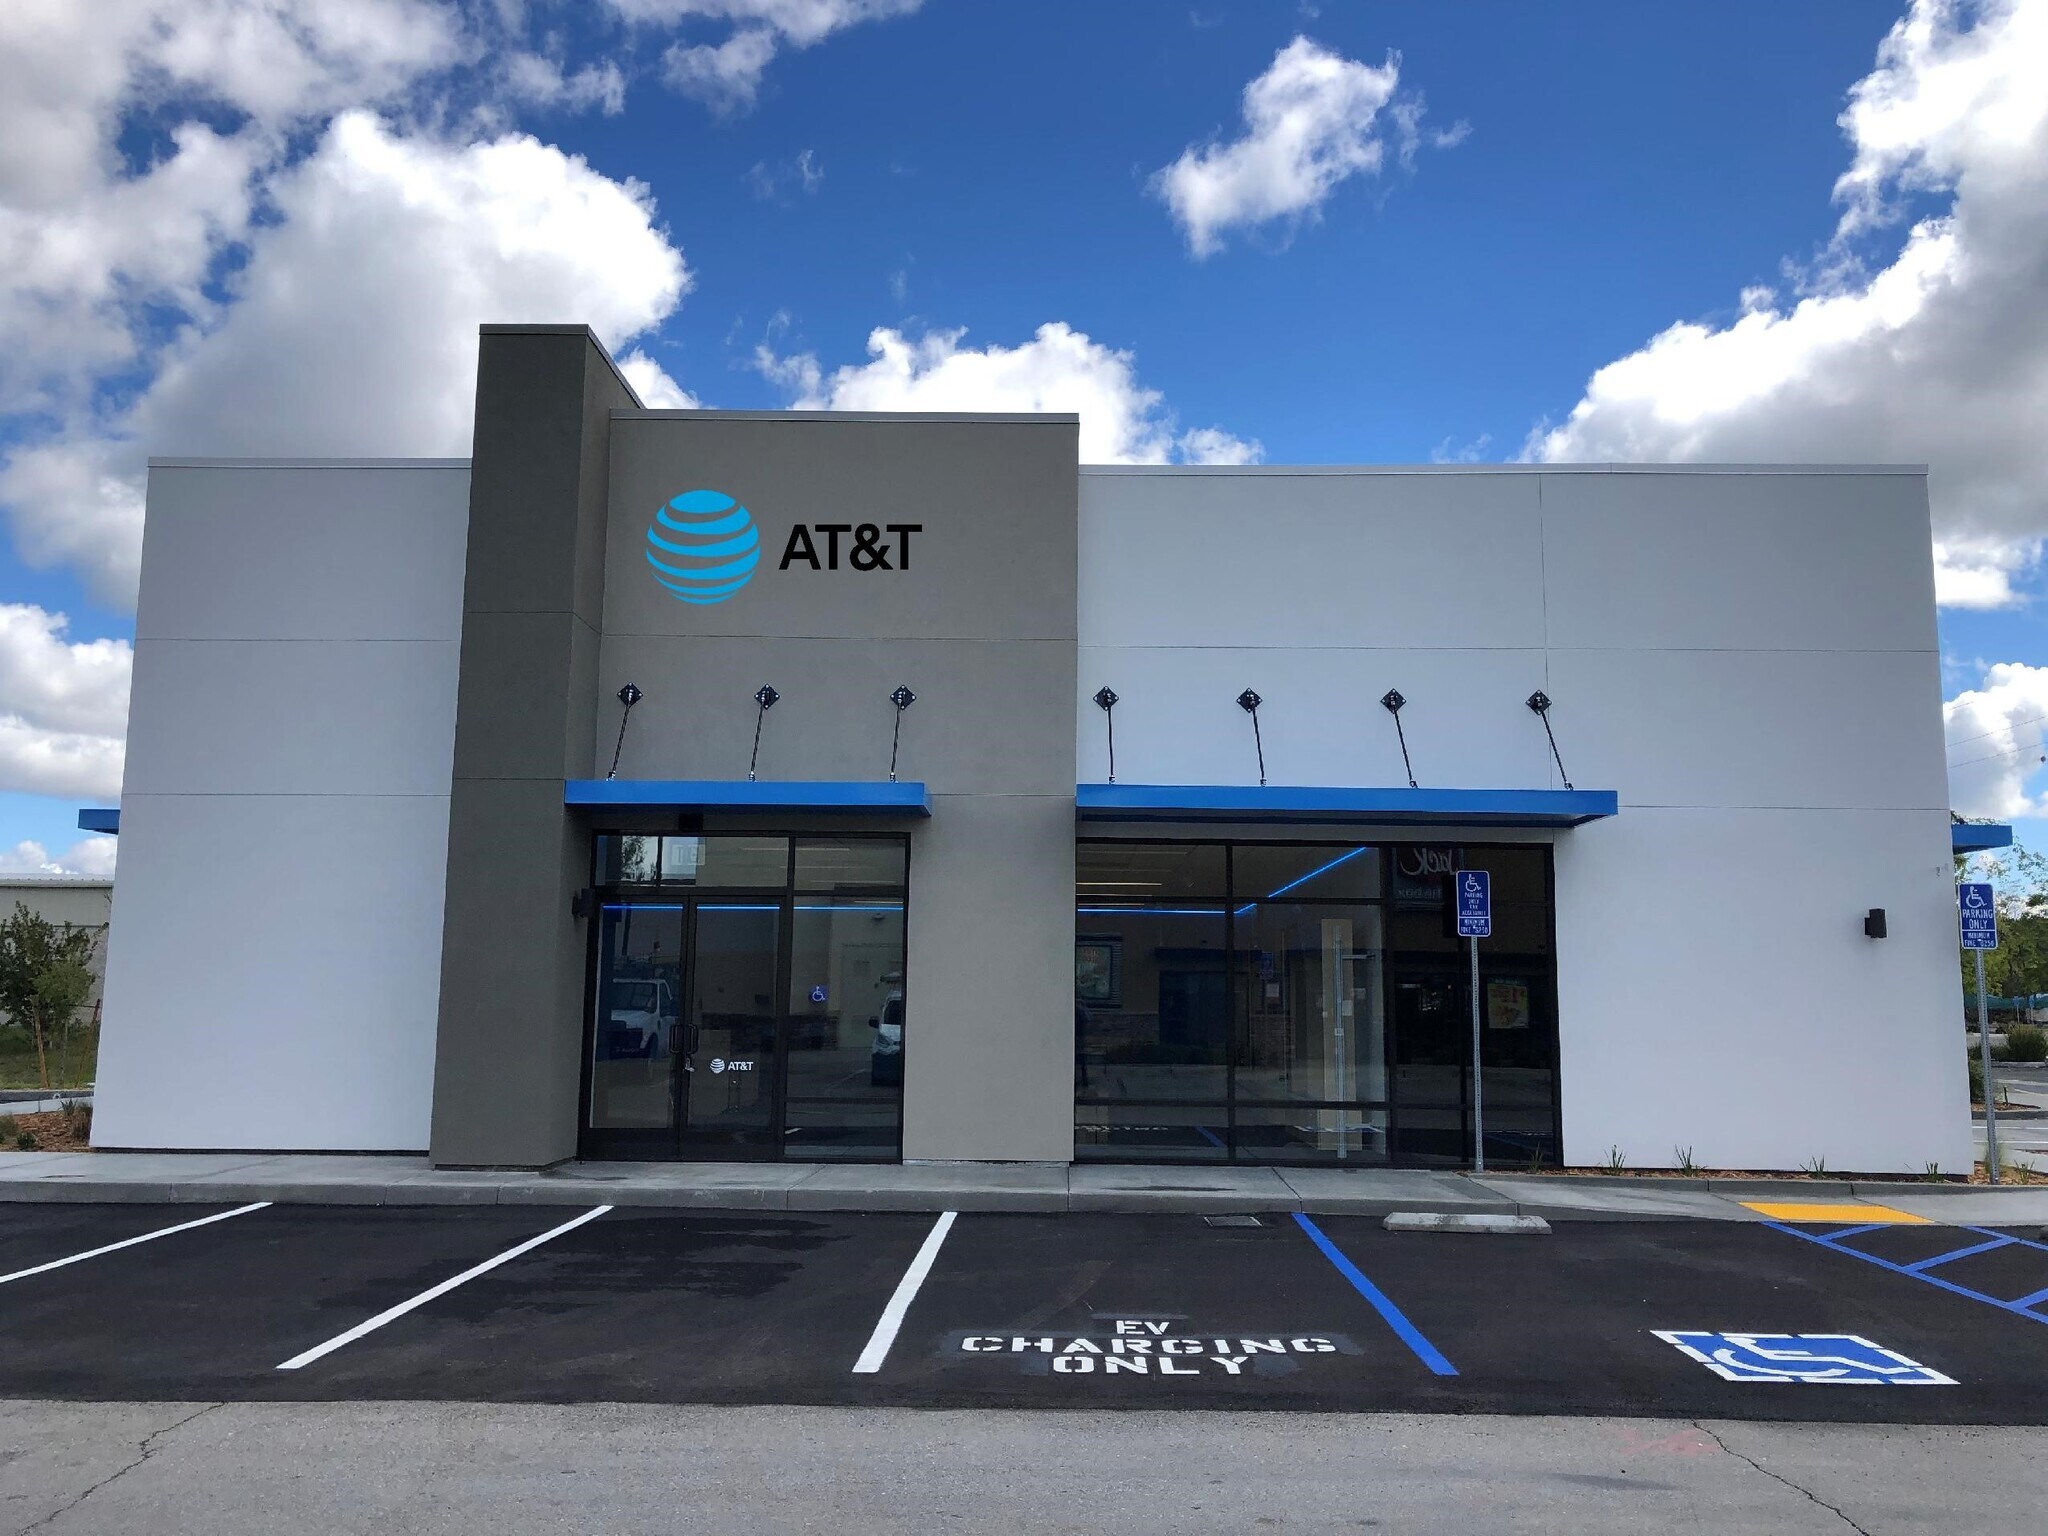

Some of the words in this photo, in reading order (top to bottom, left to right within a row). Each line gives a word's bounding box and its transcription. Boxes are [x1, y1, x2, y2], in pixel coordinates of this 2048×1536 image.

[779, 523, 922, 571] AT&T
[1962, 909, 1993, 918] PARKING
[1968, 919, 1987, 928] ONLY
[727, 1062, 754, 1070] AT&T
[1116, 1320, 1170, 1335] EV
[961, 1335, 1337, 1355] CHARGING
[1053, 1356, 1250, 1376] ONLY
